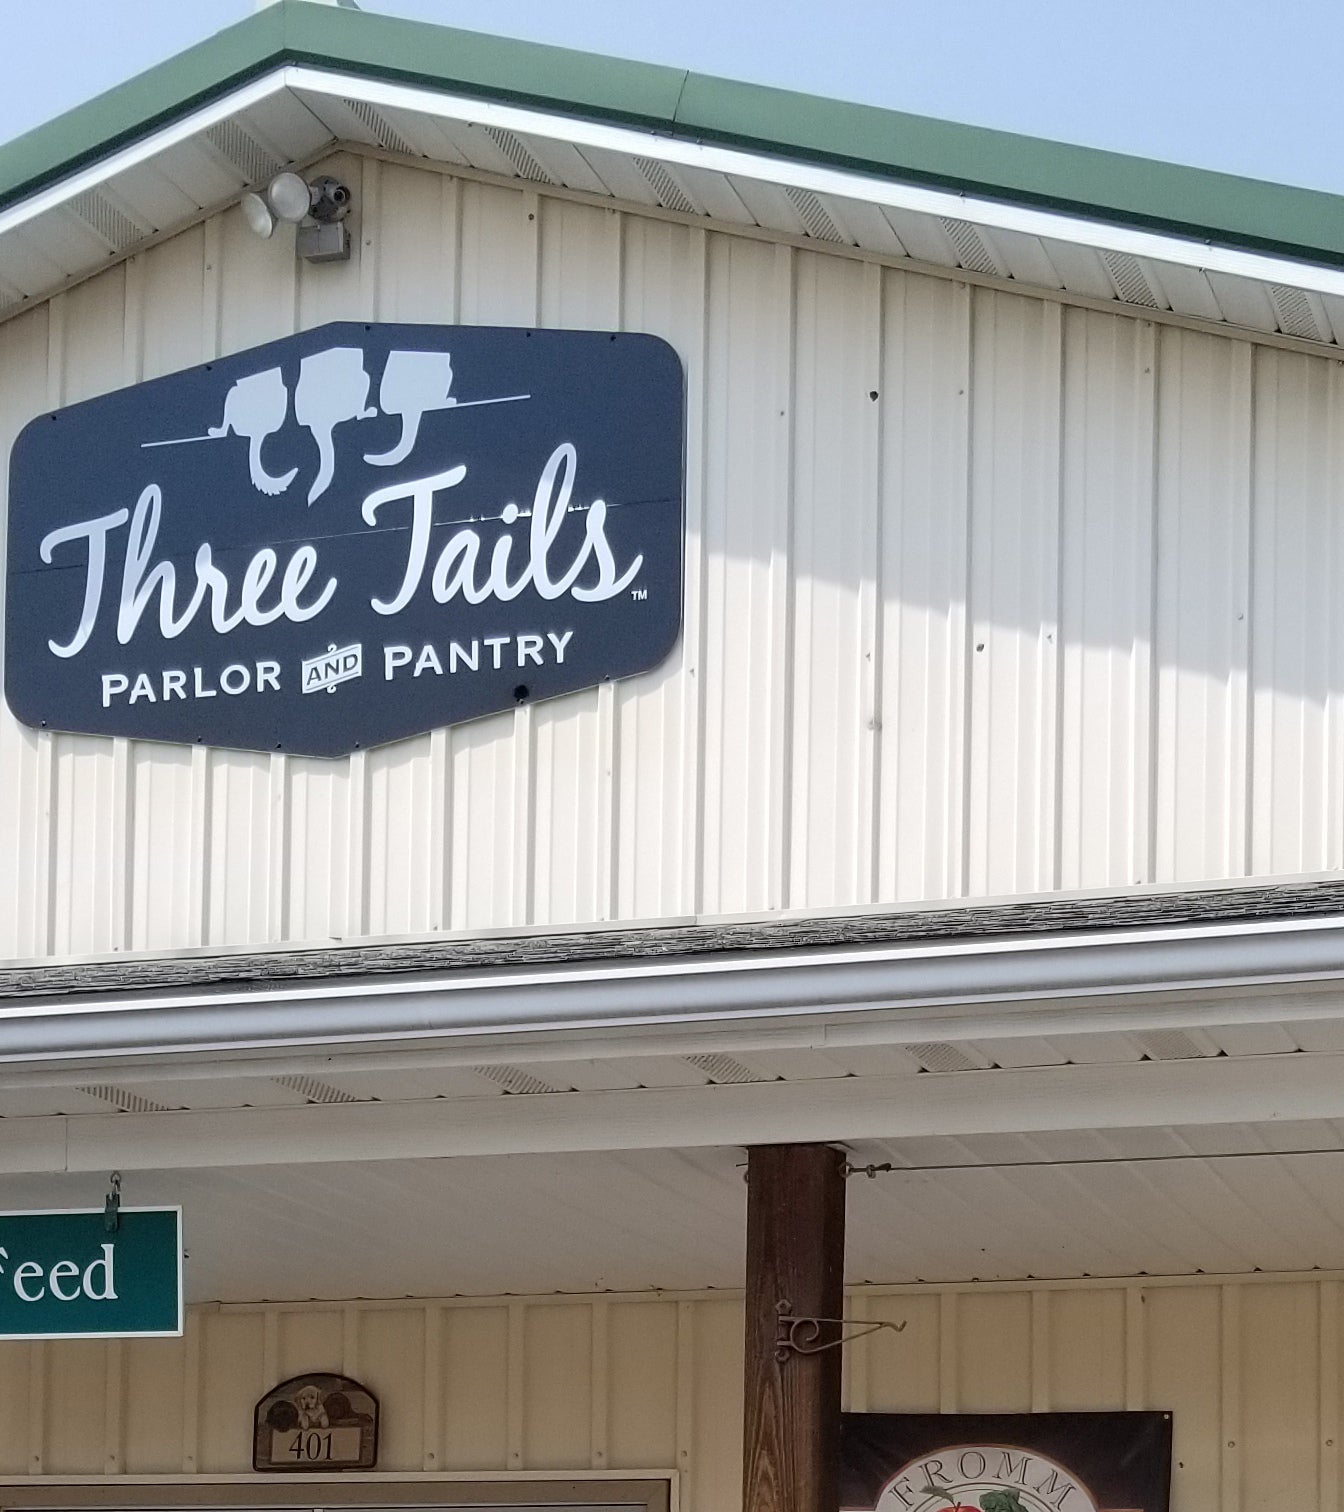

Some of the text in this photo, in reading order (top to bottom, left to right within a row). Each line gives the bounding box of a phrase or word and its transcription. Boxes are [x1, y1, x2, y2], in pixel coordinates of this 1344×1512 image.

[40, 484, 337, 658] Three
[362, 443, 643, 615] Tails
[101, 631, 574, 708] PARLOR AND PANTRY
[288, 1431, 333, 1461] 401
[888, 1450, 1077, 1511] FROMM
